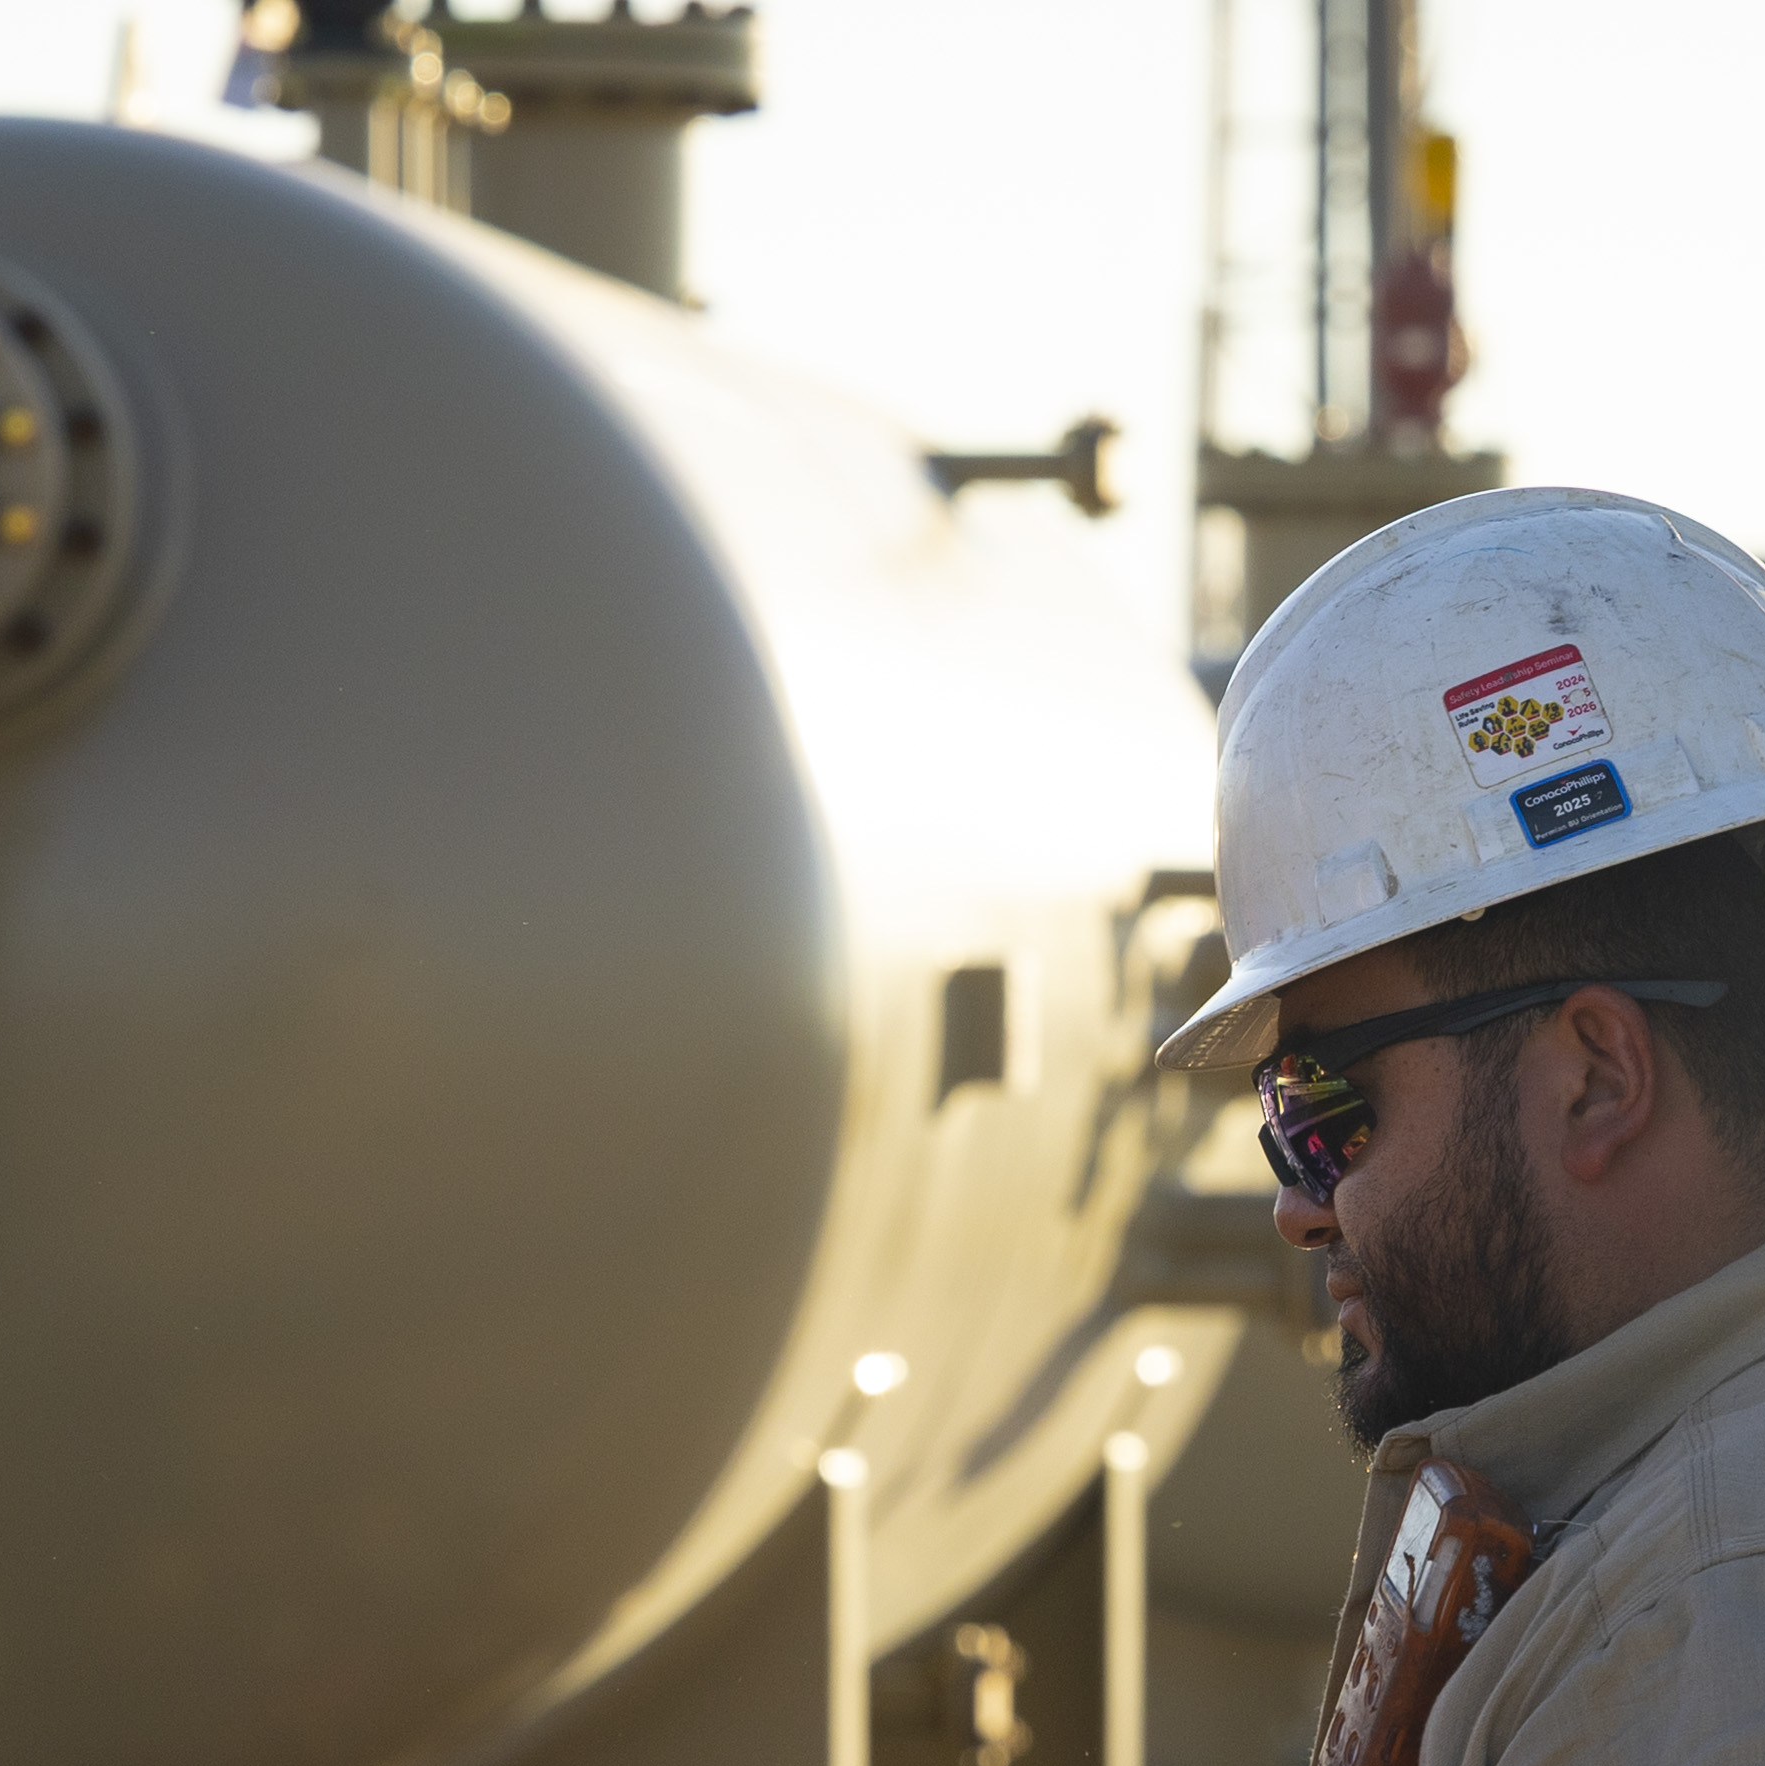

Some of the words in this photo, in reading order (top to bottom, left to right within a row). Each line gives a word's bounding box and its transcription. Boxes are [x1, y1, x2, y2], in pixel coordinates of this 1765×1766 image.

[1448, 686, 1480, 705] Safety
[1534, 650, 1574, 671] Seminar
[1555, 673, 1585, 691] 2024
[1561, 687, 1592, 705] 25
[1566, 701, 1597, 718] 2026
[1552, 728, 1605, 750] ConocoPhillips
[1524, 771, 1606, 808] ConocoPhillips
[1553, 793, 1592, 818] 2025
